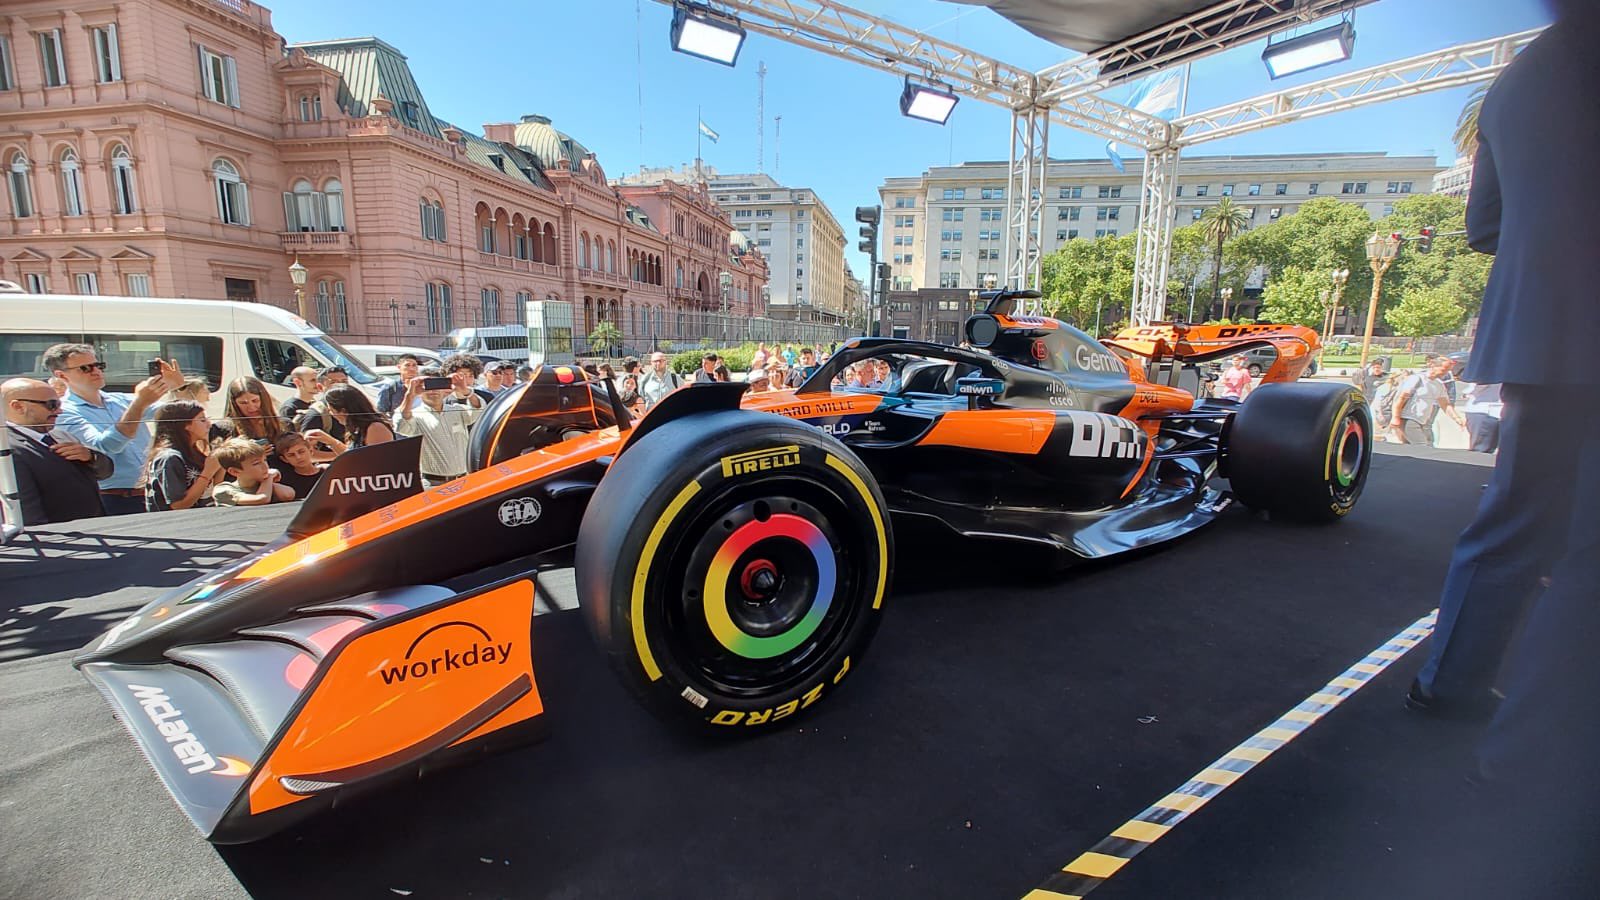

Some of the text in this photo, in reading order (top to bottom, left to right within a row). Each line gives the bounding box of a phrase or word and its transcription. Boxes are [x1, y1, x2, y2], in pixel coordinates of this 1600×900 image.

[1075, 345, 1127, 374] Gemini
[816, 400, 855, 413] MILLE
[720, 445, 800, 478] PIRELLI
[328, 472, 413, 496] ARROW
[379, 640, 513, 686] workday
[710, 656, 850, 726] P ZERO
[127, 683, 217, 776] McLaren
